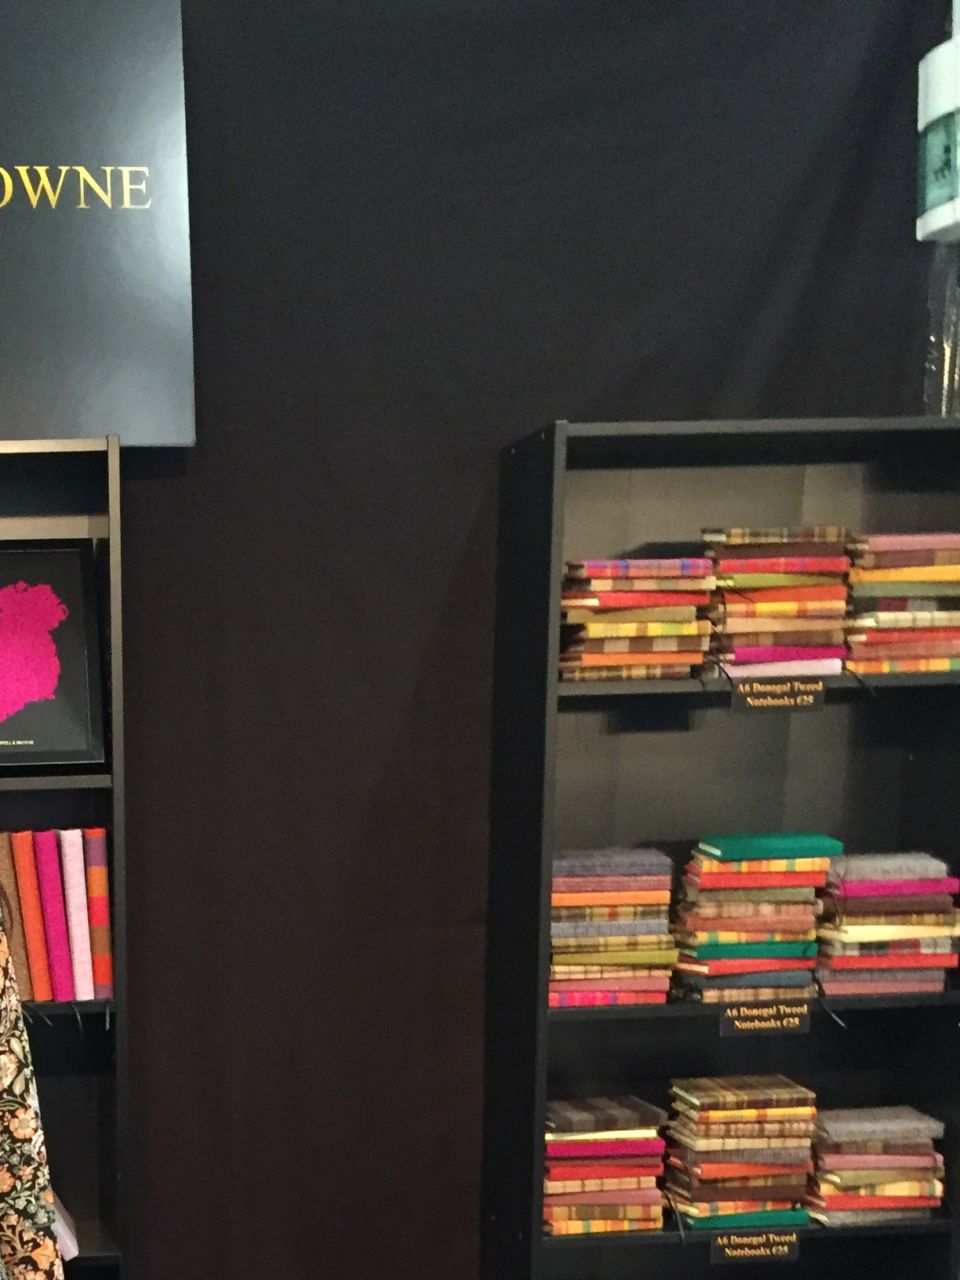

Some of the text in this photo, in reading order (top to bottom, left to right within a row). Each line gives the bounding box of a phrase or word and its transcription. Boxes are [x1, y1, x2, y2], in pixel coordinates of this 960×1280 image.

[752, 681, 791, 694] Donegal
[793, 680, 824, 692] Tweed
[746, 695, 795, 707] Notebooks
[739, 1005, 777, 1018] Donegal
[778, 1003, 808, 1015] Tweed
[734, 1018, 781, 1030] Notebooks
[730, 1233, 766, 1246] Donegal
[767, 1232, 797, 1244] Tweed
[724, 1245, 771, 1257] Notebooks
